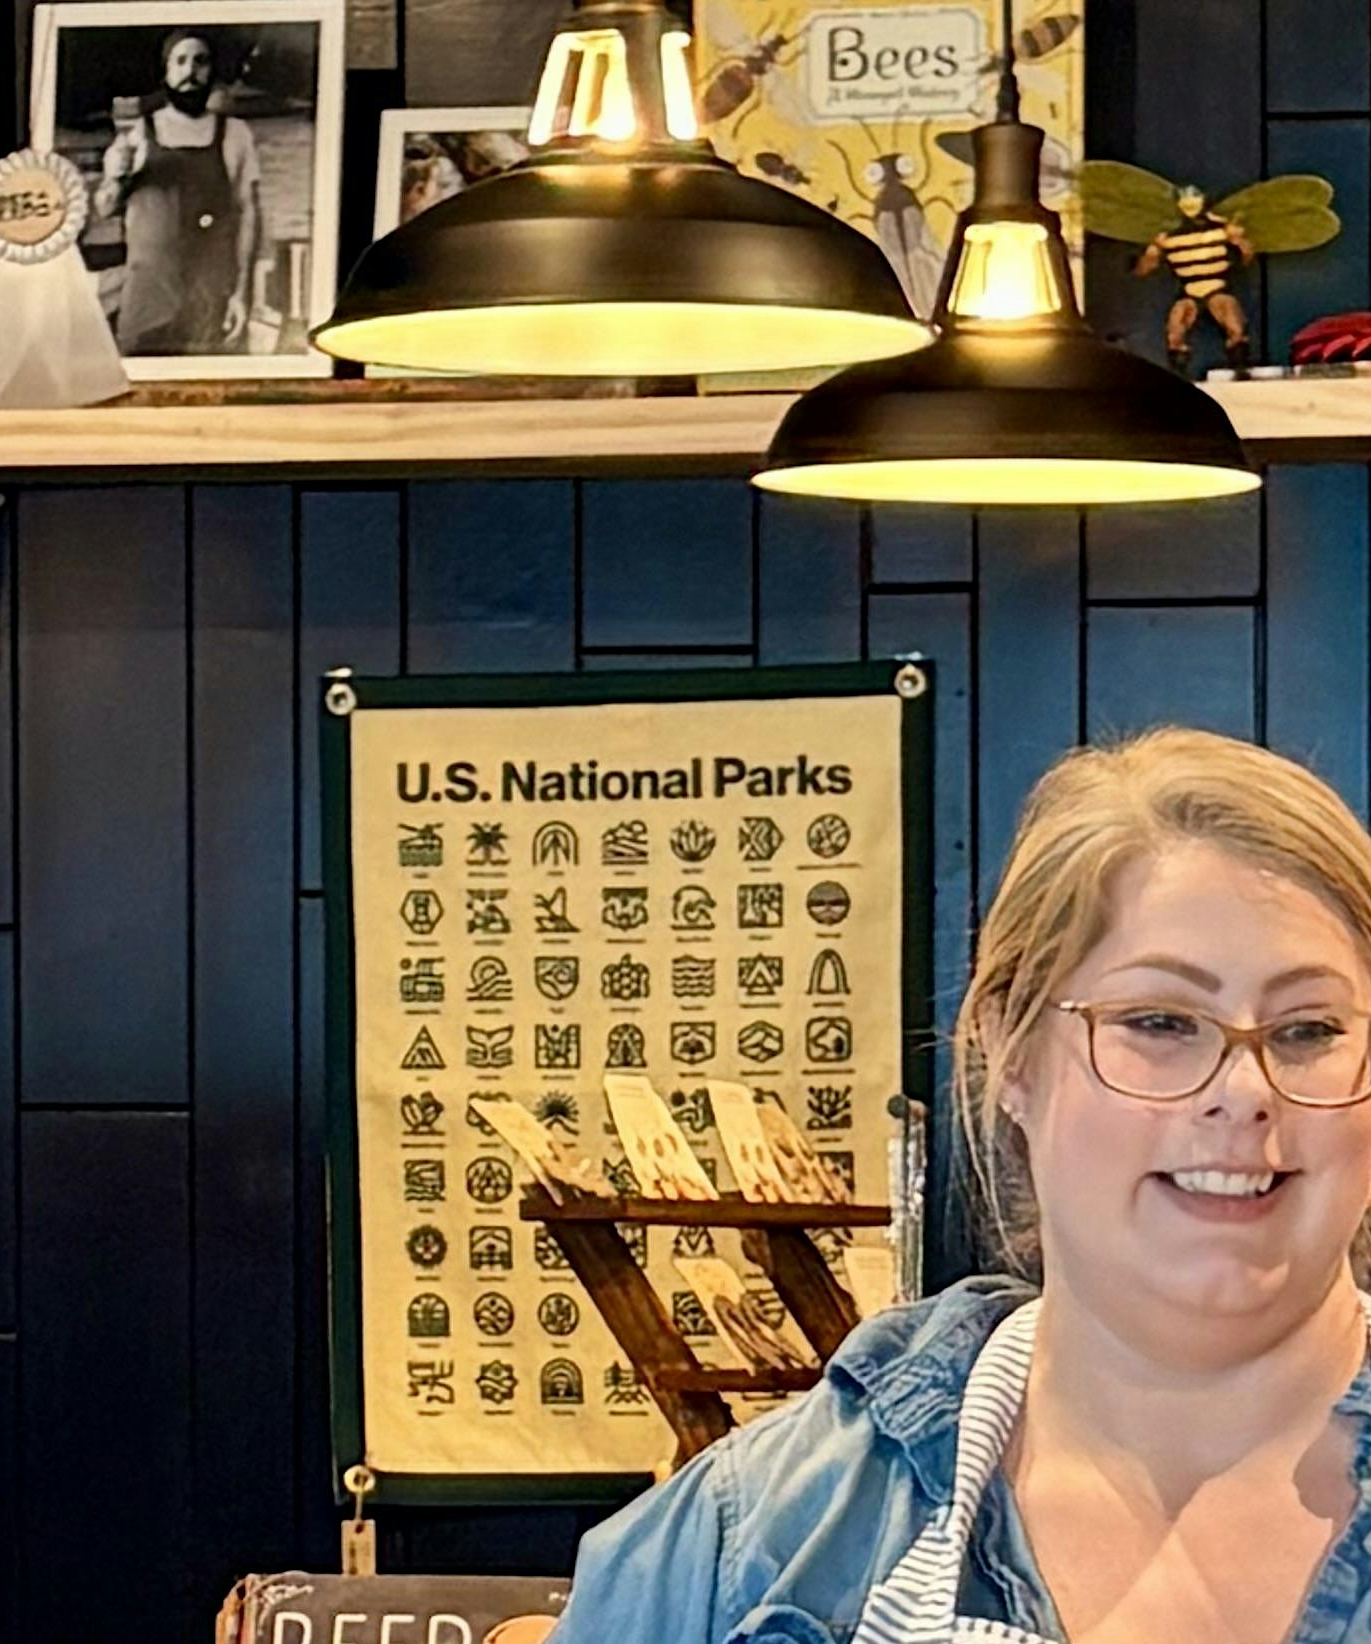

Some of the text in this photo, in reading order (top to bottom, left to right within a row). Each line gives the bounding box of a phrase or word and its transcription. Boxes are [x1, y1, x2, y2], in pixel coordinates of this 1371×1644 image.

[828, 25, 959, 82] Bees
[397, 755, 851, 801] U.S. National Parks
